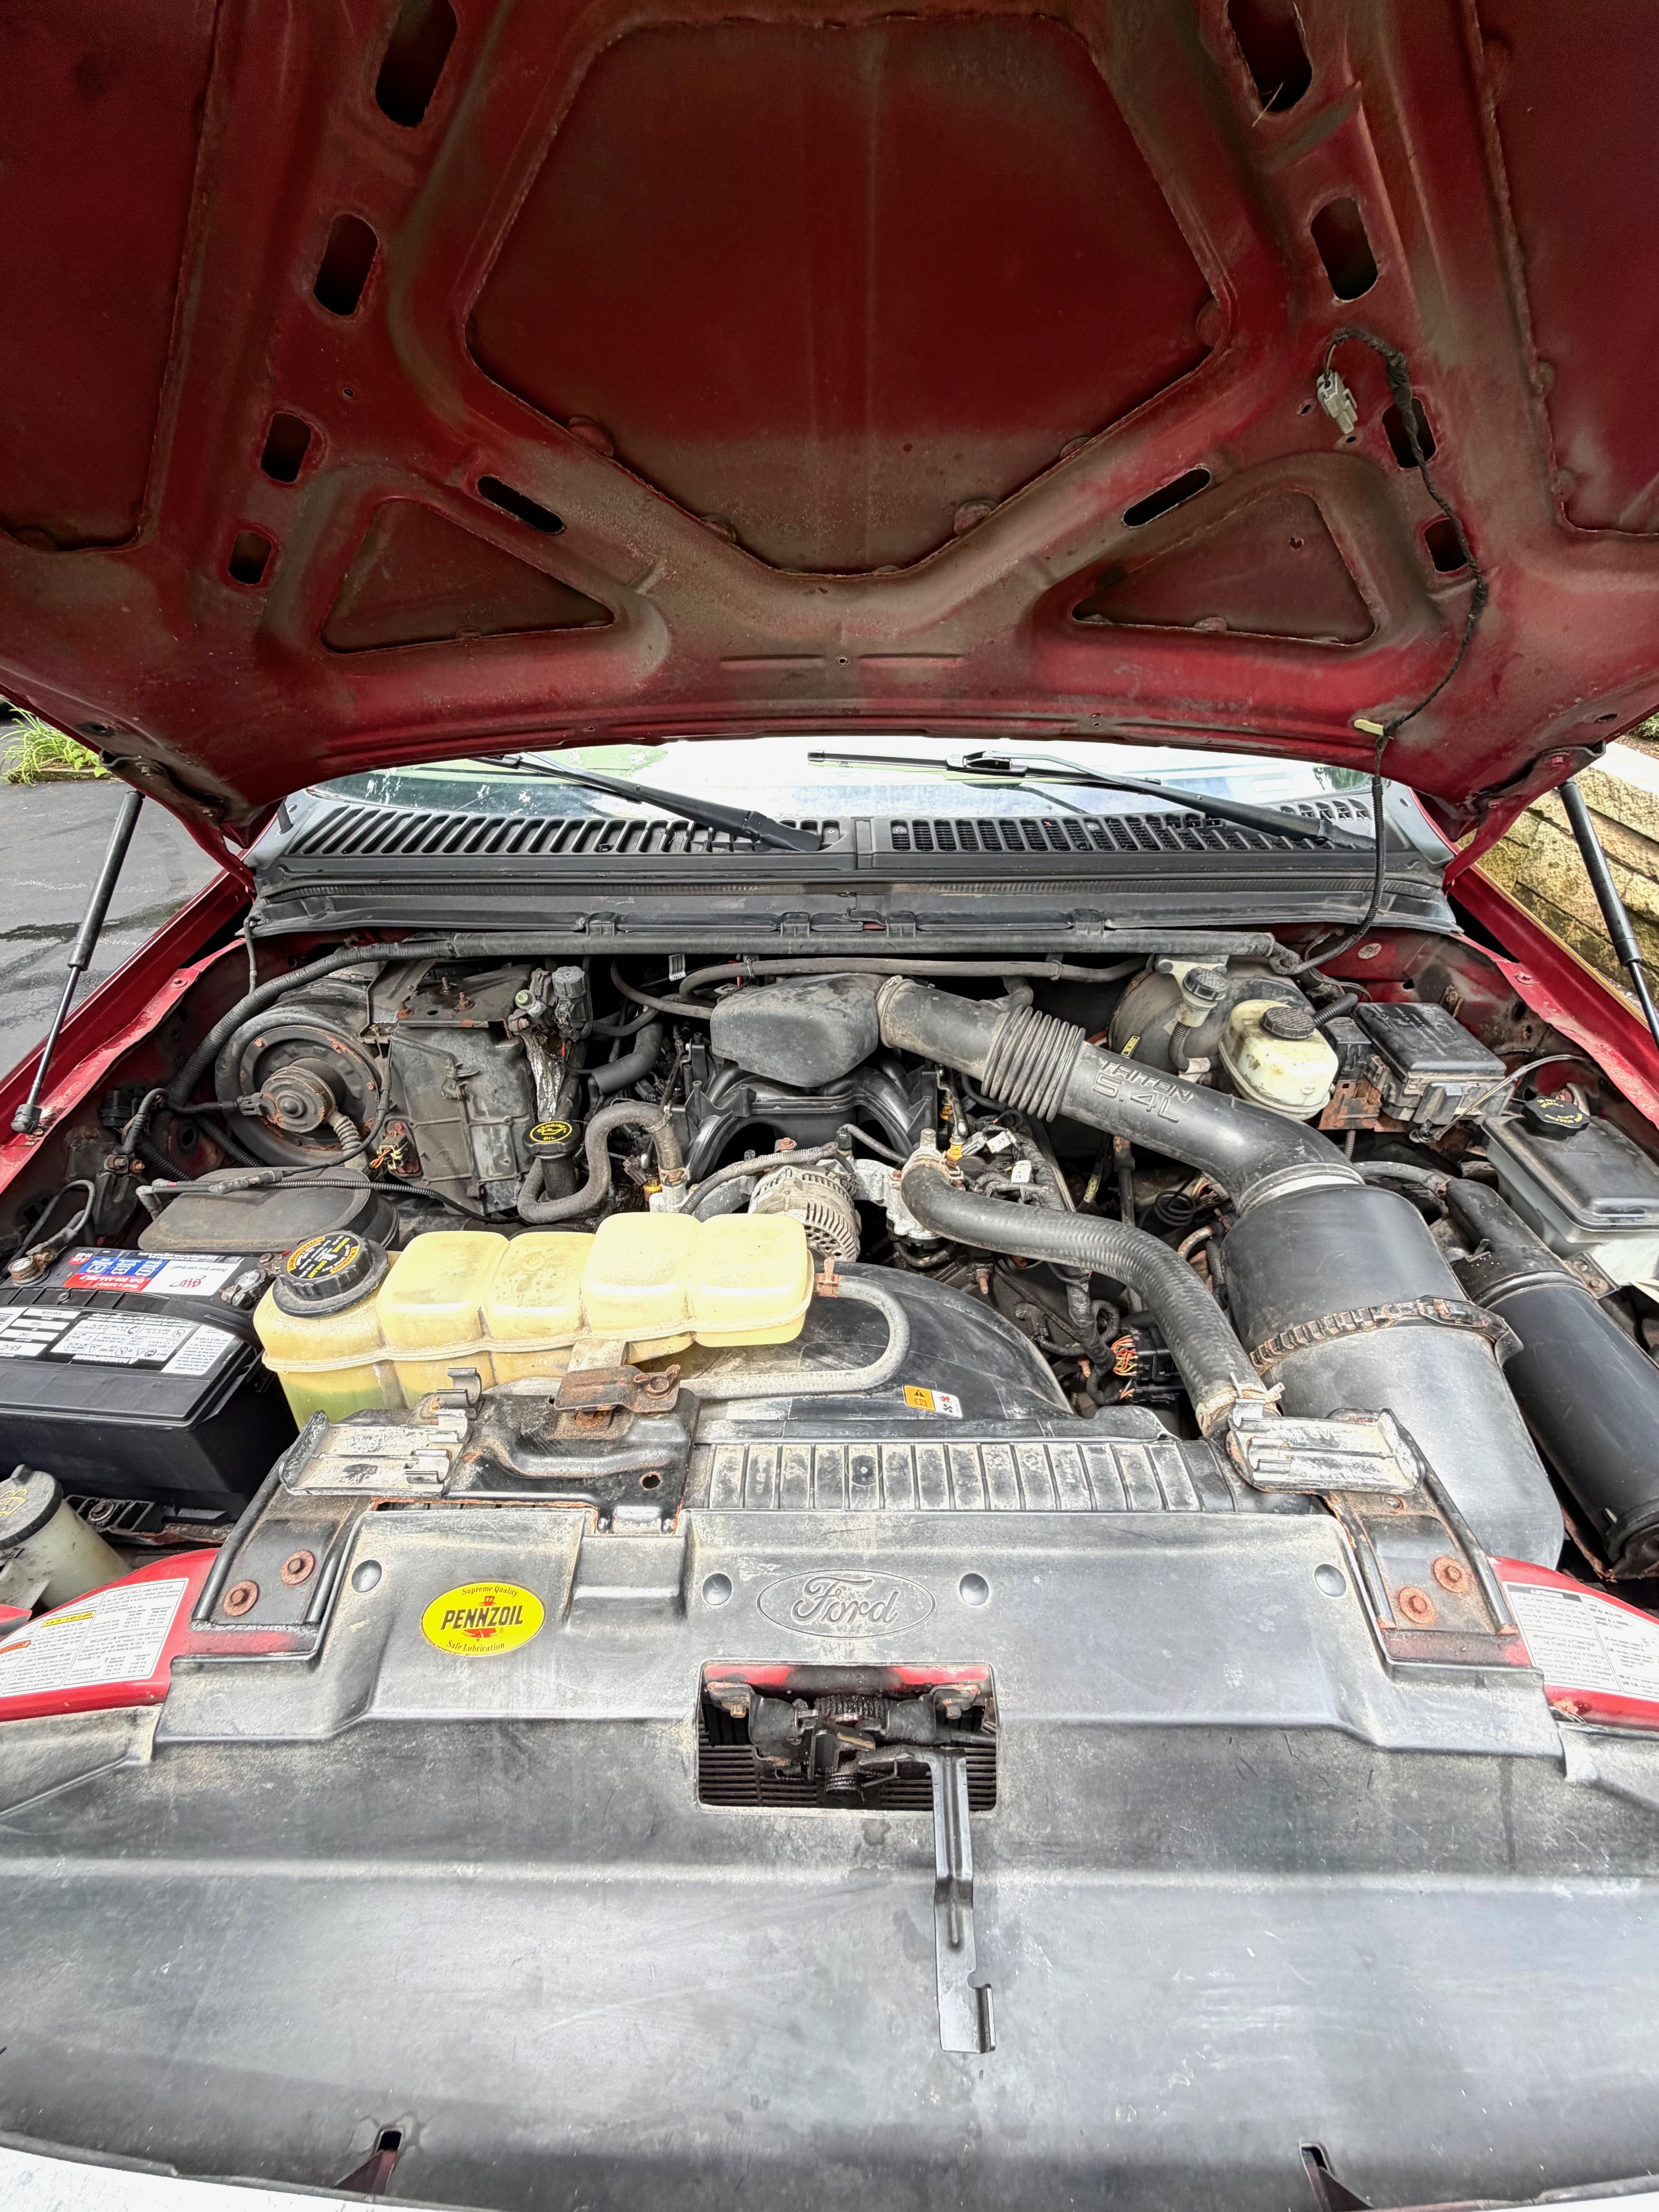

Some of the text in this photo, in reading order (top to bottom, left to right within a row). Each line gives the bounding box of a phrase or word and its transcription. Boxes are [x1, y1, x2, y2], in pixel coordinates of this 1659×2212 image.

[1101, 1058, 1193, 1101] TRITON
[1093, 1072, 1179, 1123] 5.4L
[333, 1251, 356, 1271] WARNING
[462, 1585, 519, 1597] Supreme Quality
[792, 1577, 900, 1625] Ford
[440, 1605, 523, 1630] PENNZOIL
[447, 1640, 505, 1652] Safe Lubrication
